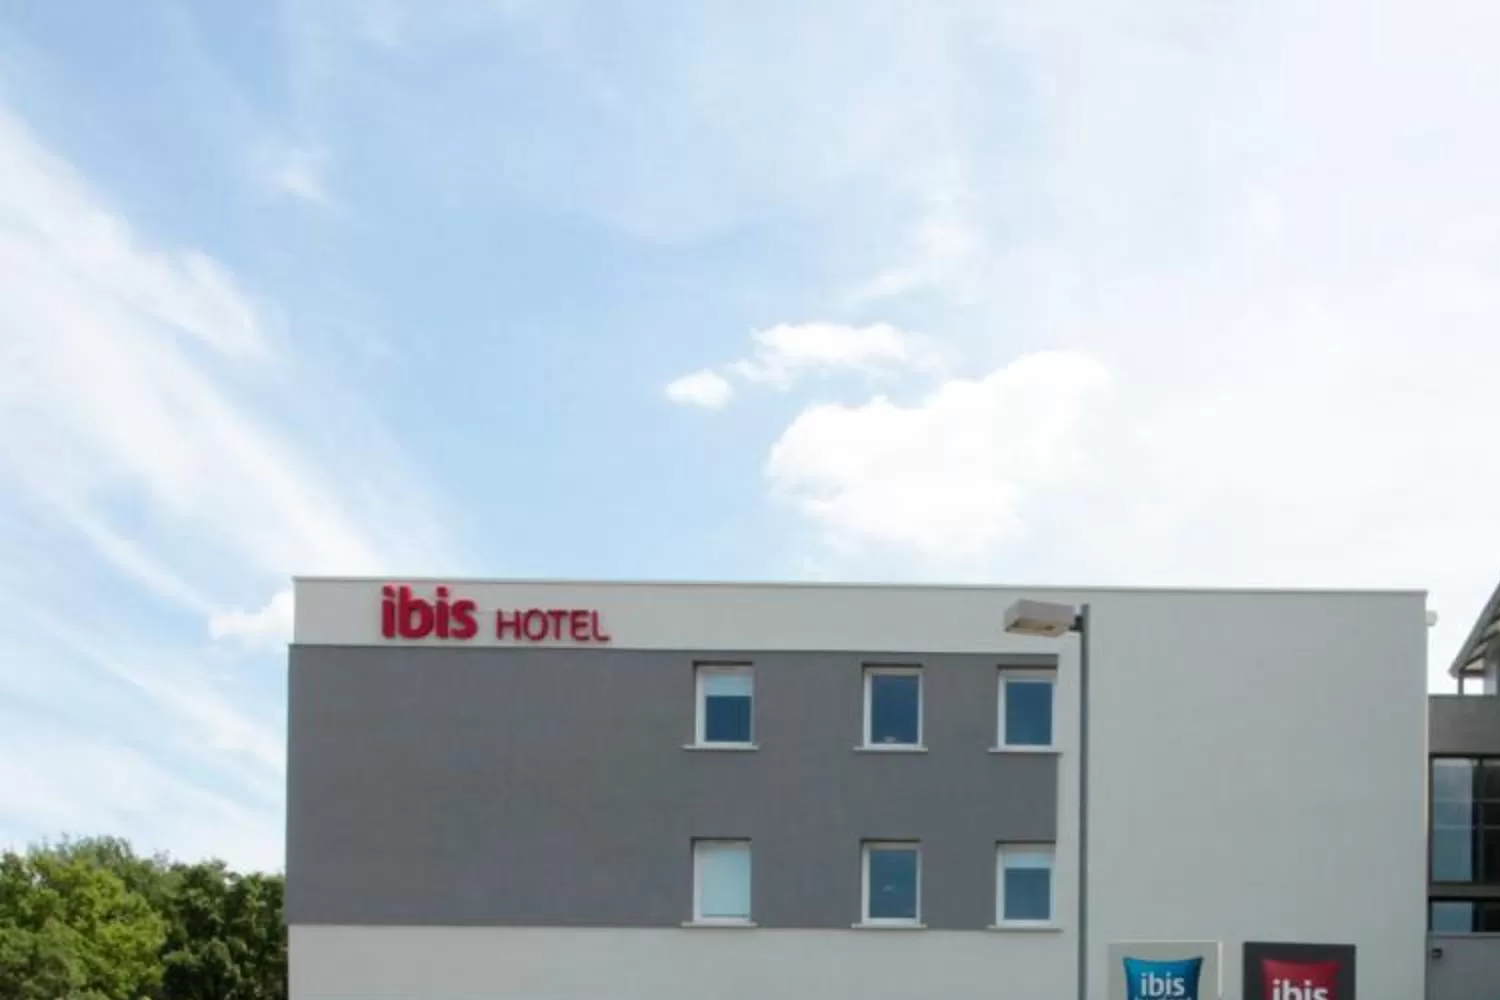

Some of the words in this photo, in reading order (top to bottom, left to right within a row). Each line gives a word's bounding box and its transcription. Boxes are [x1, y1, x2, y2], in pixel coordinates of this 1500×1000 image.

[382, 585, 479, 639] ibis
[495, 608, 611, 642] HOTEL
[1140, 971, 1185, 997] ibis
